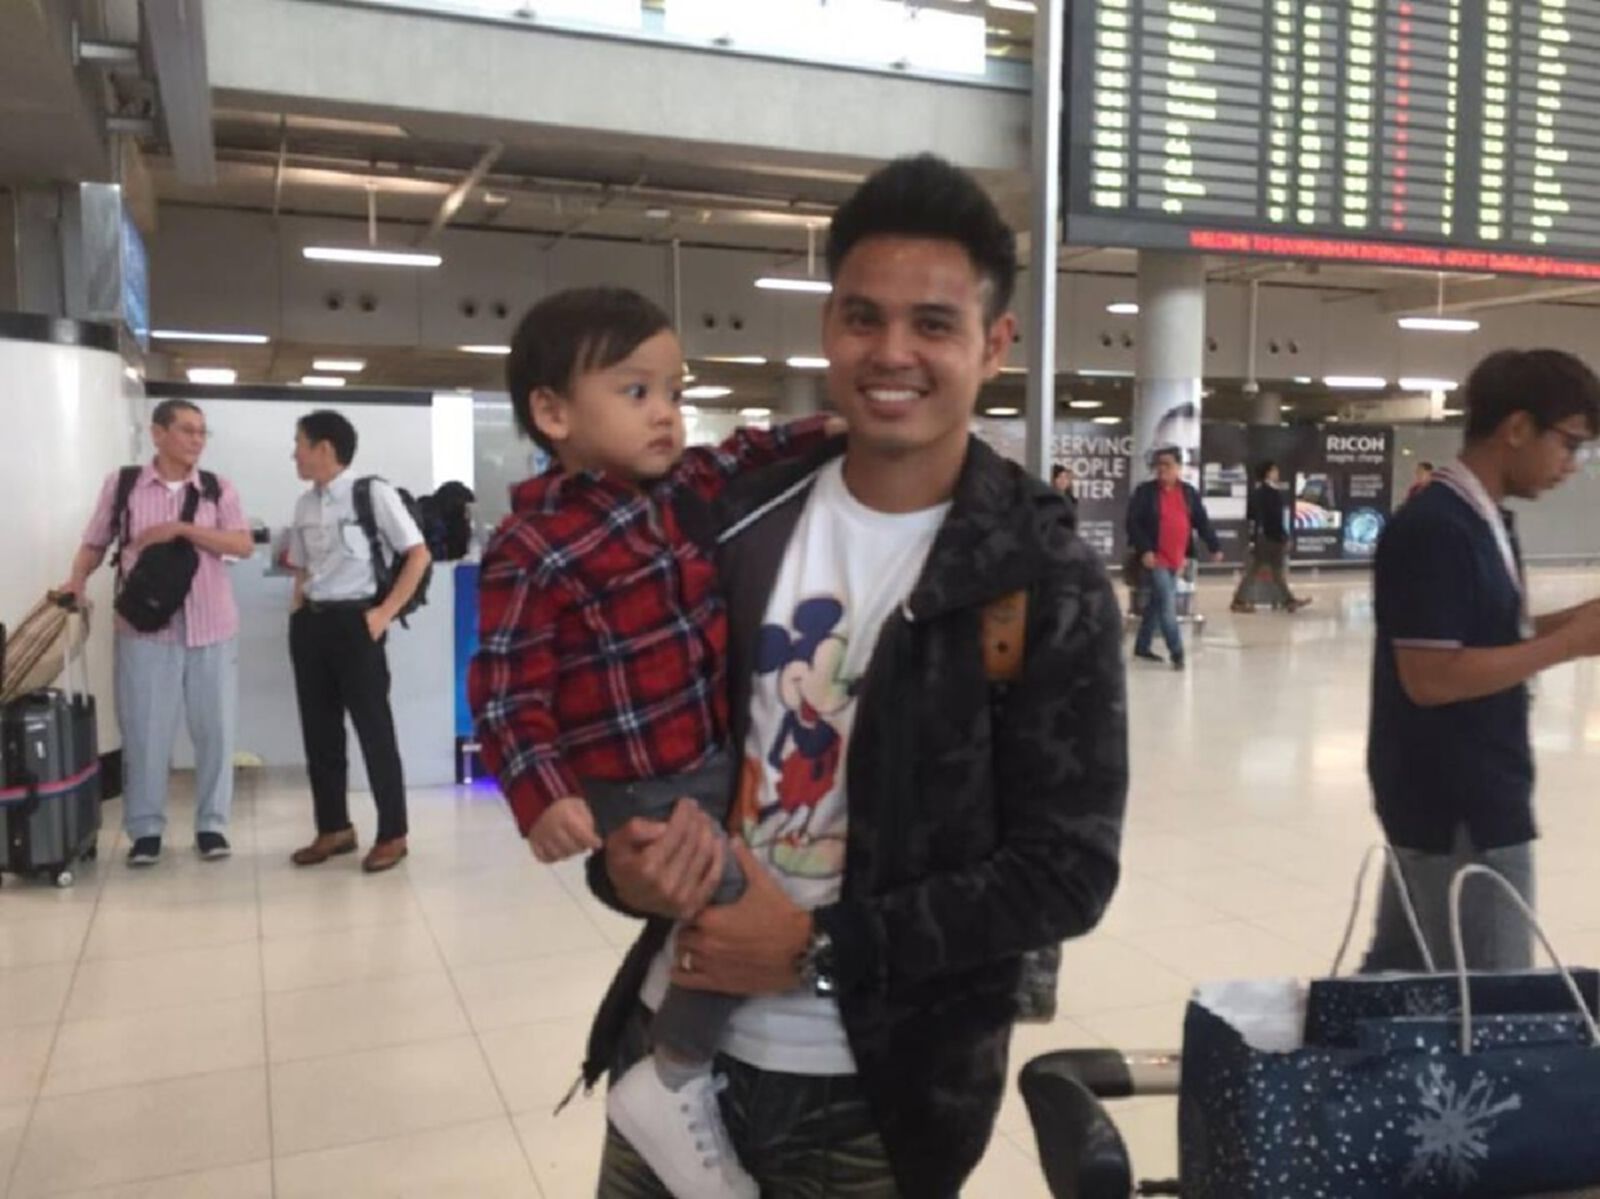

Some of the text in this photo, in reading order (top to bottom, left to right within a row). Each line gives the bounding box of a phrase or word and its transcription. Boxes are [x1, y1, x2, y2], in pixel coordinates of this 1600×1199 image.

[1053, 434, 1134, 456] SERVING
[1326, 435, 1385, 451] RICOH
[1071, 479, 1115, 498] TTER
